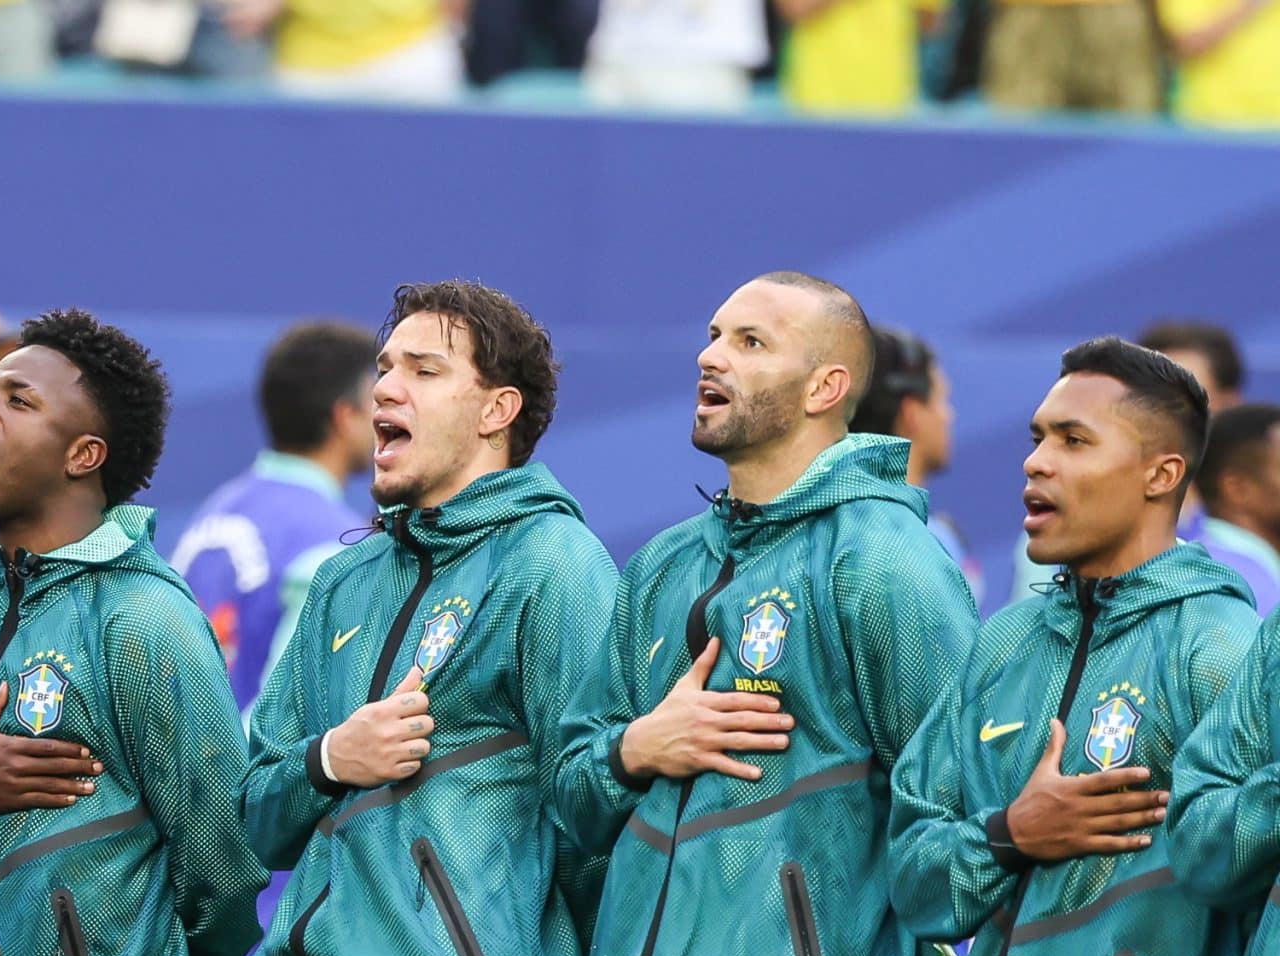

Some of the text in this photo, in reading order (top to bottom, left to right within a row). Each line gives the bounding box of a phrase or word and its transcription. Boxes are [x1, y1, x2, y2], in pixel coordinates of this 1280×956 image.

[755, 631, 771, 640] CBF
[735, 678, 783, 693] BRASIL
[32, 692, 50, 701] CBF
[1103, 726, 1121, 735] CBF
